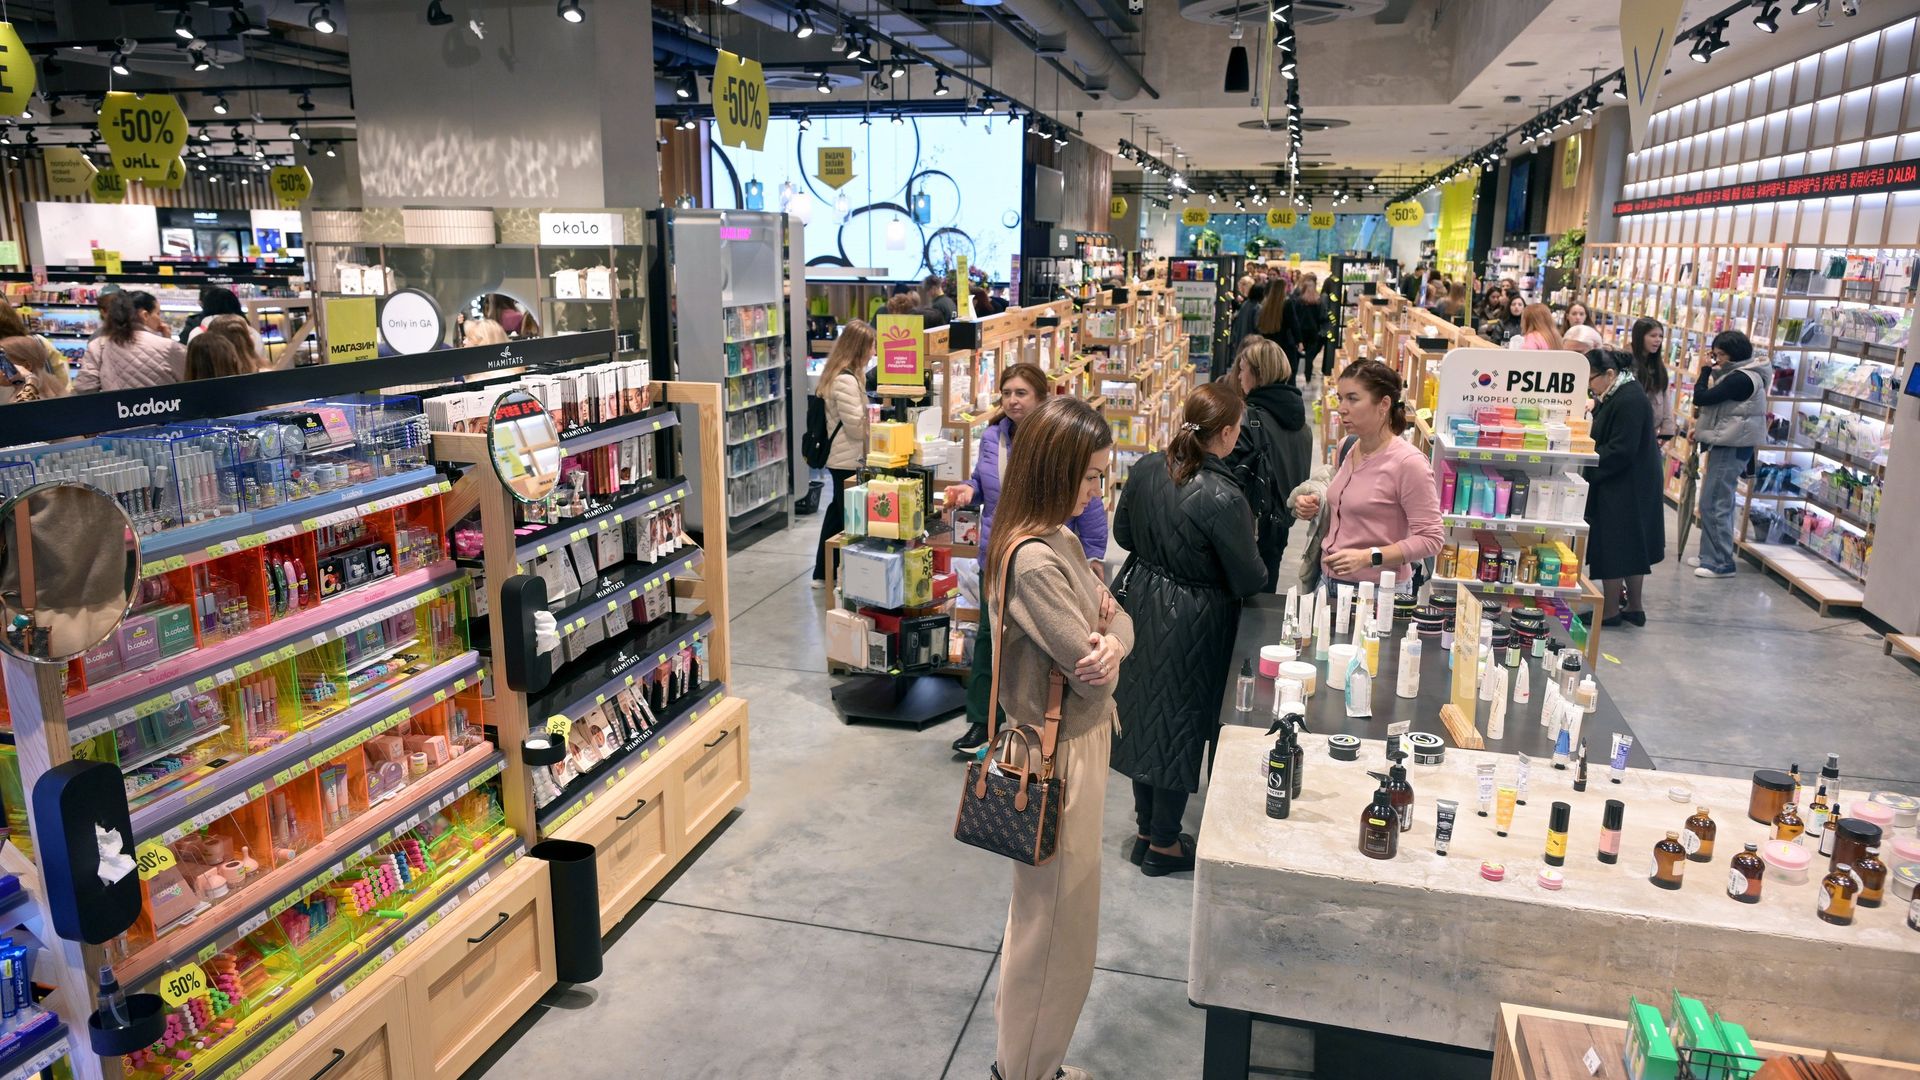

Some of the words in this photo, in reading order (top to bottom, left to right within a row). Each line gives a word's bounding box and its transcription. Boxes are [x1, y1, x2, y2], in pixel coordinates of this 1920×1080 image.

[723, 76, 762, 130] -50%
[112, 108, 174, 144] -50%
[97, 174, 122, 191] SALE
[277, 174, 305, 191] -50%
[1272, 213, 1292, 224] SALE
[1313, 216, 1331, 226] SALE
[1392, 208, 1418, 221] -50%
[552, 221, 599, 235] okolo
[389, 319, 408, 330] Only
[410, 318, 418, 328] in
[420, 318, 433, 328] GA
[331, 341, 375, 354] МАГАЗИН
[487, 355, 524, 369] MIAMITATS
[1506, 370, 1576, 394] PSLAB
[1478, 395, 1509, 404] КОРЕИ
[117, 398, 181, 419] b.colour
[561, 425, 592, 440] MIAMITATS
[583, 504, 614, 519] MIAMITATS
[596, 580, 625, 599] MIAMITATS
[164, 623, 190, 638] b.colour
[127, 637, 154, 651] b.colour
[85, 649, 114, 664] b.colour
[611, 654, 640, 675] MIAMITATS
[148, 669, 180, 684] b.colour
[625, 729, 653, 752] MIAMITATS
[167, 971, 201, 998] -50%
[245, 1013, 272, 1037] b.colour
